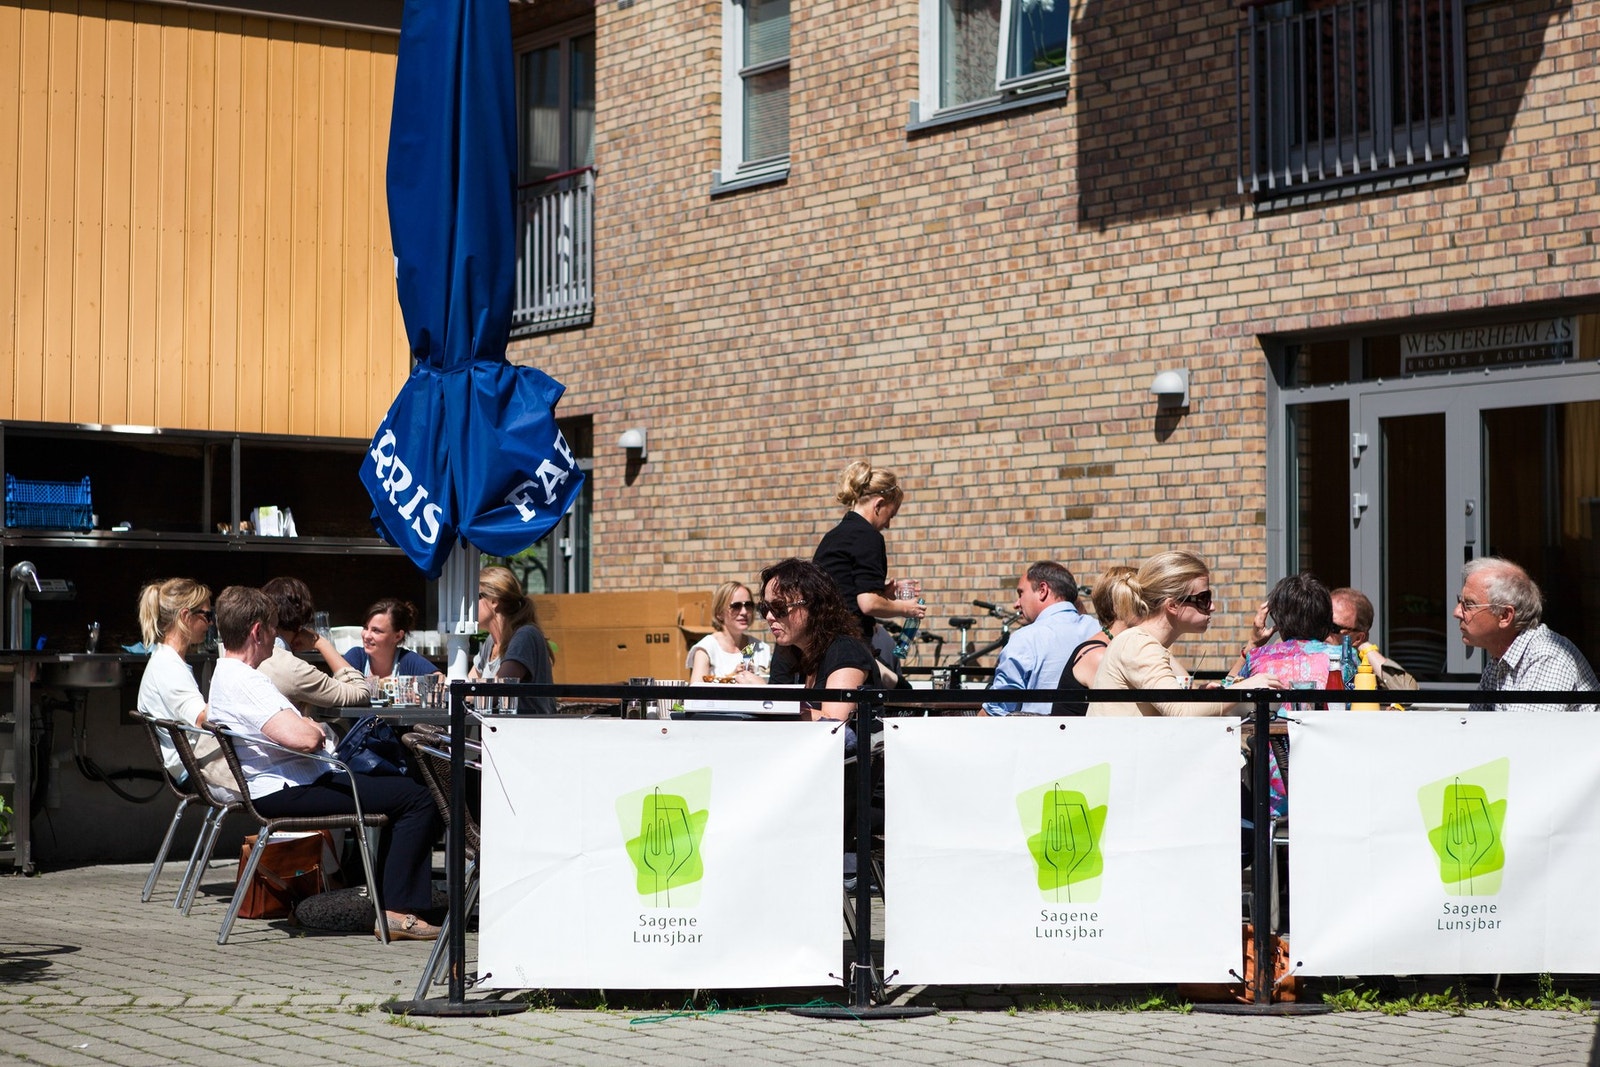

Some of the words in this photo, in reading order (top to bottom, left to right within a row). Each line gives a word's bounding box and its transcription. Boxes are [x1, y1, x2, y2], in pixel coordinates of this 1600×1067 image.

[1405, 322, 1538, 355] WESTERHEIM
[1545, 318, 1571, 341] AS
[1408, 356, 1467, 370] ENGROS
[1496, 347, 1569, 361] AGENTUR
[370, 420, 443, 544] RRIS
[1040, 909, 1099, 925] Sagene
[1443, 902, 1498, 918] Sagene
[638, 914, 698, 930] Sagene
[1437, 917, 1502, 933] Lunsjbar
[633, 931, 703, 946] Lunsjbar
[1035, 926, 1105, 941] Lunsjbar
